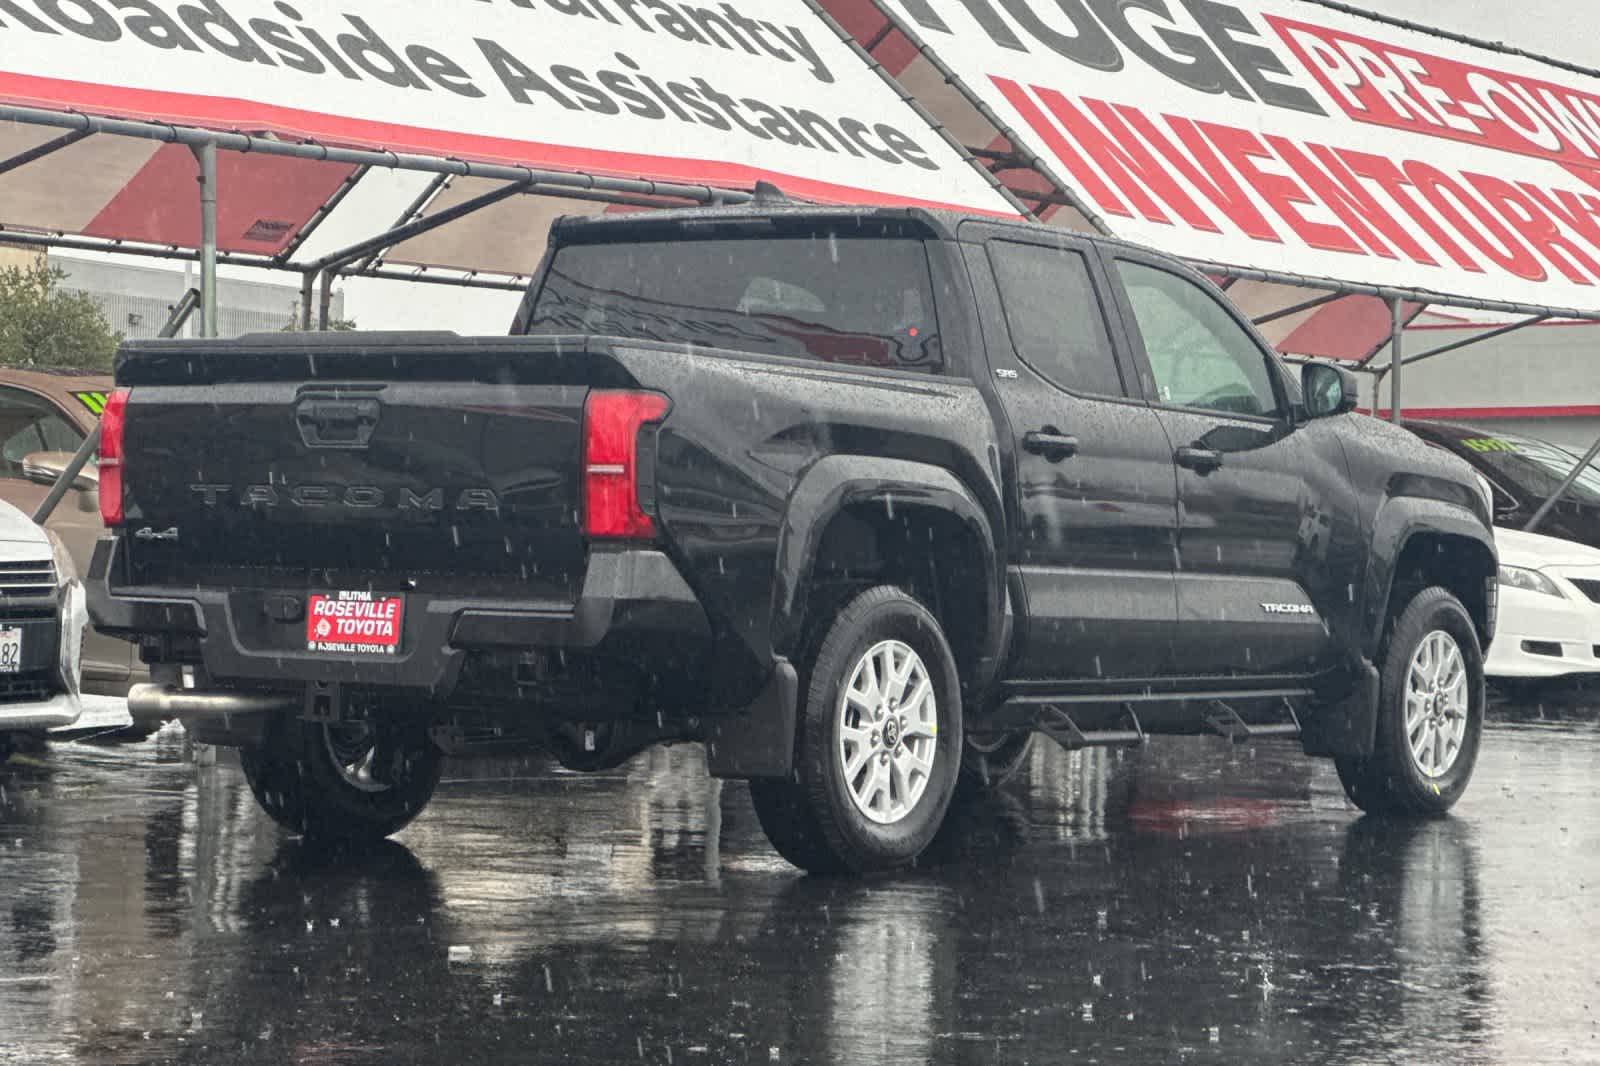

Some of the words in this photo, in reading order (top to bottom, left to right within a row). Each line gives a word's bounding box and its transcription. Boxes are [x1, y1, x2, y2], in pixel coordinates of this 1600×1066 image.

[474, 0, 834, 83] ranty
[472, 37, 940, 170] Assistance
[1285, 27, 1600, 159] PRE-OW
[189, 484, 498, 511] TACOMA
[313, 600, 396, 618] ROSEVILLE
[1261, 603, 1314, 614] TACOMA
[336, 619, 393, 636] TOYOTA
[317, 642, 356, 652] ROSEVILLE
[357, 643, 385, 653] TOYOTA
